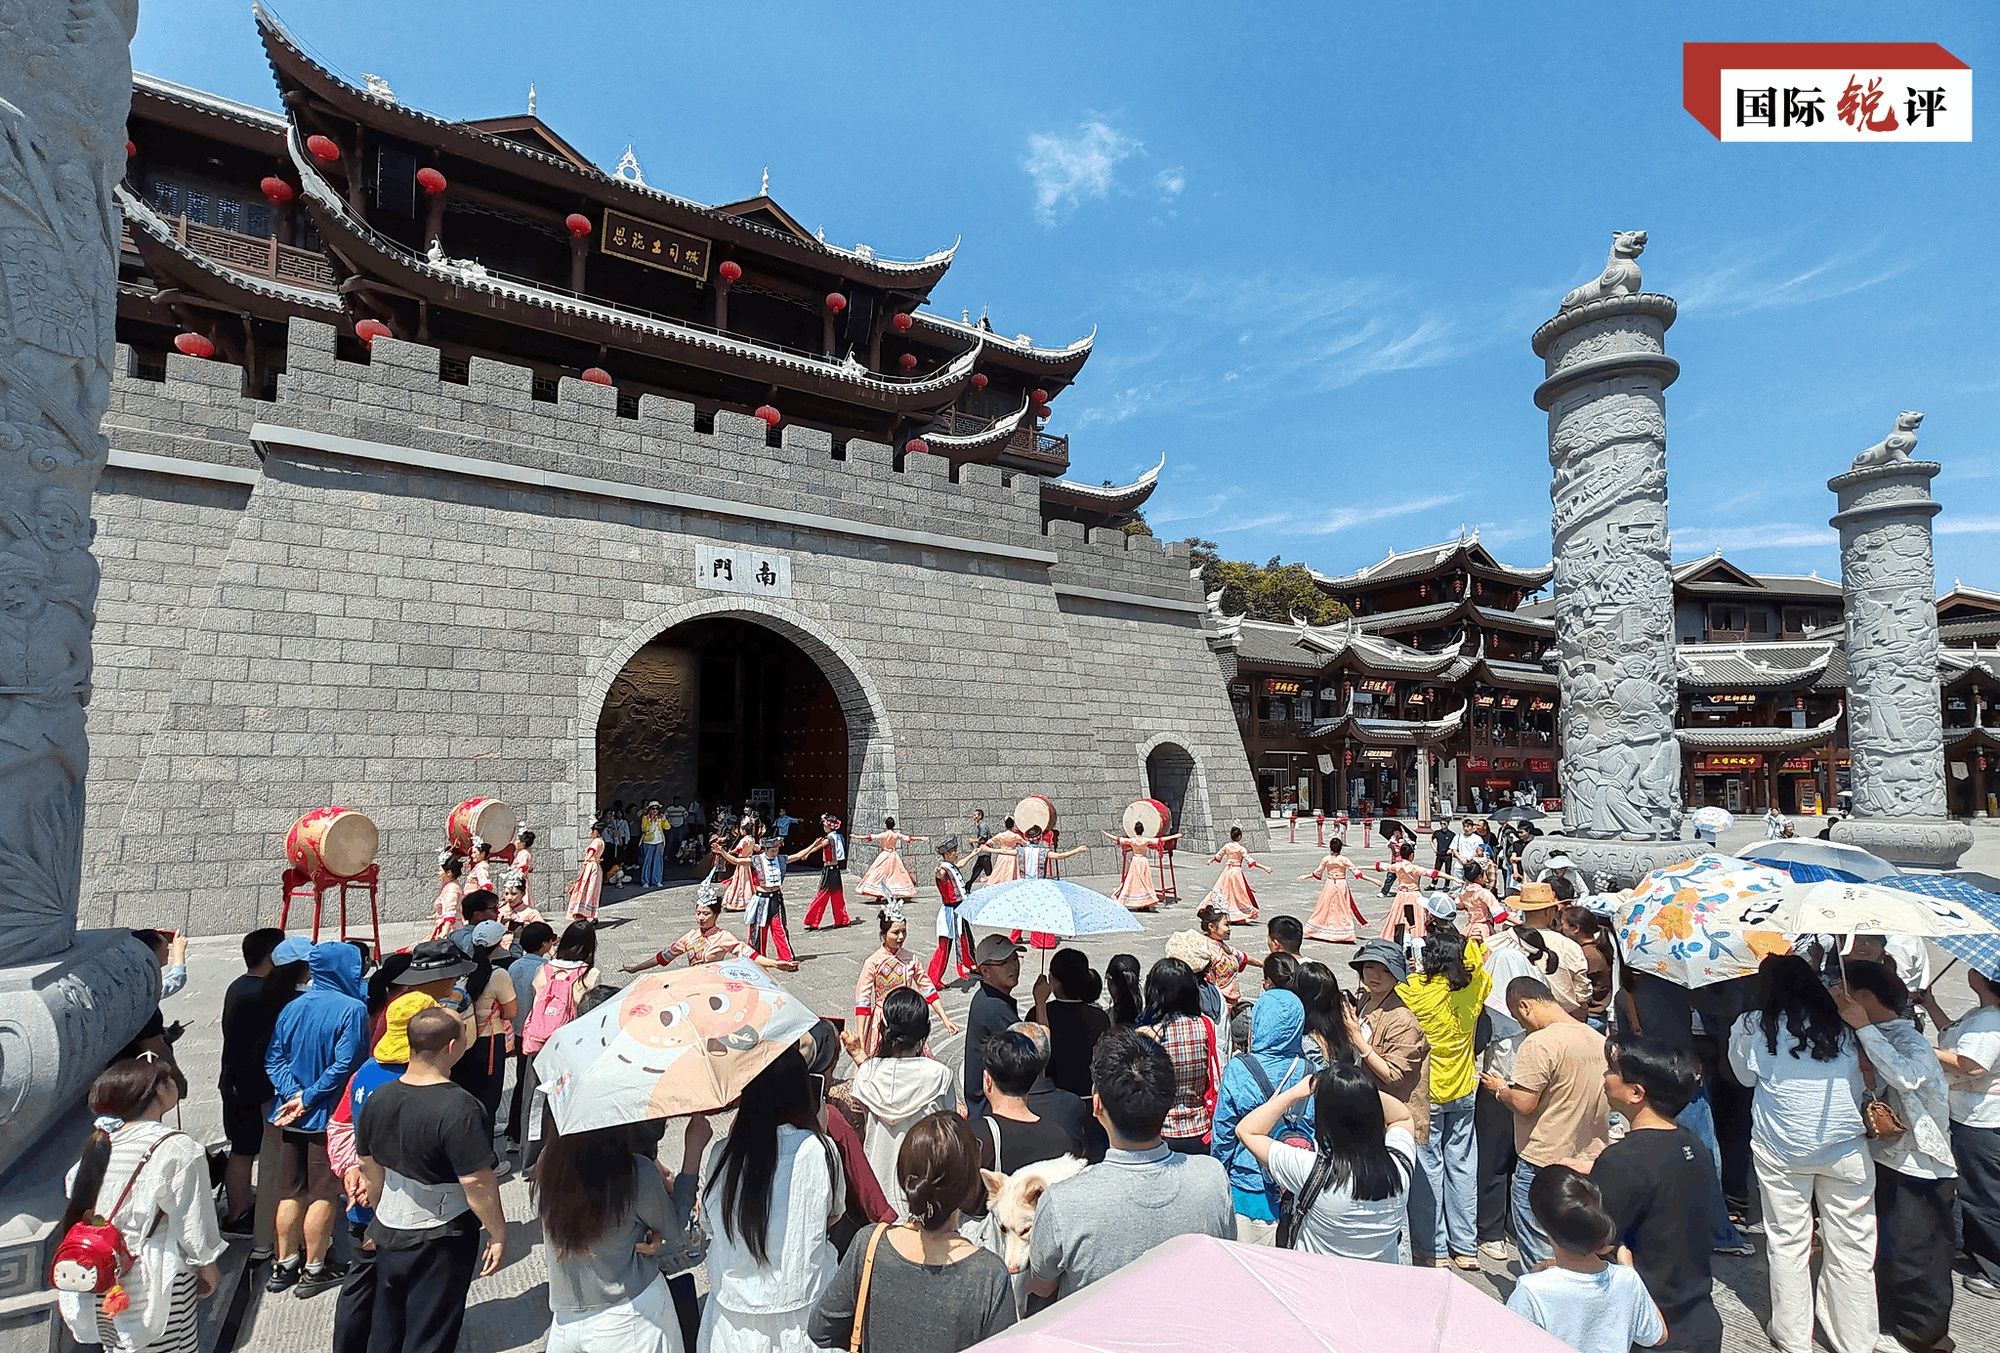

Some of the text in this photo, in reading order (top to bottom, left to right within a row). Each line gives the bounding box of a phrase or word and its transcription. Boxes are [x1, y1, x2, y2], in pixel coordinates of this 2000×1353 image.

[612, 226, 701, 266] 恩施土司城
